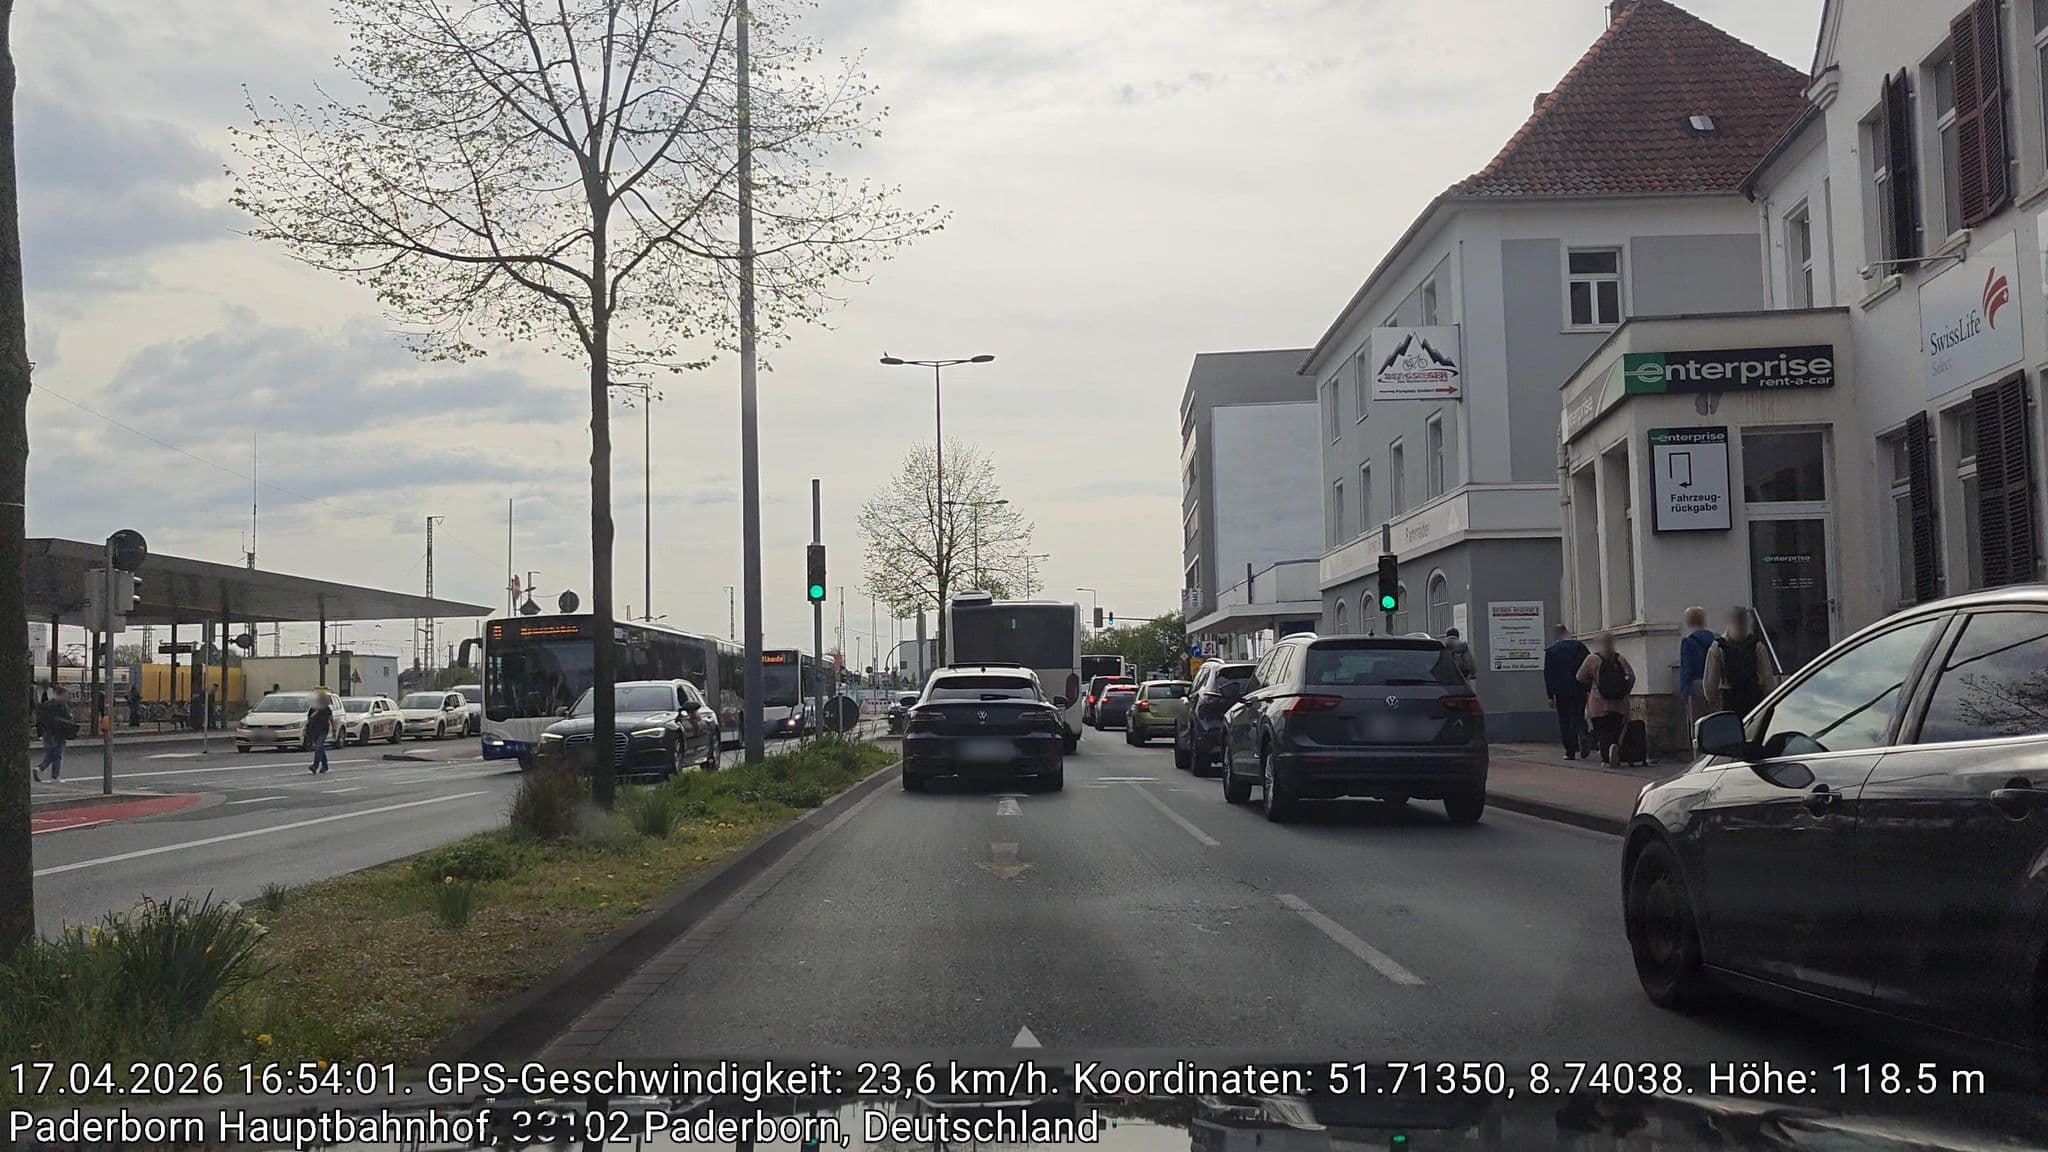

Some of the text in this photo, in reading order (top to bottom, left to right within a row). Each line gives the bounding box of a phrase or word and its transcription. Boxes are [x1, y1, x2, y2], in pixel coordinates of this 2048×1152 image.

[1633, 353, 1833, 383] enterprise
[1760, 376, 1833, 388] rent-a-car
[1655, 431, 1726, 443] enterprise
[1670, 493, 1721, 503] Fahrzeug-
[1671, 503, 1718, 513] rückgabe
